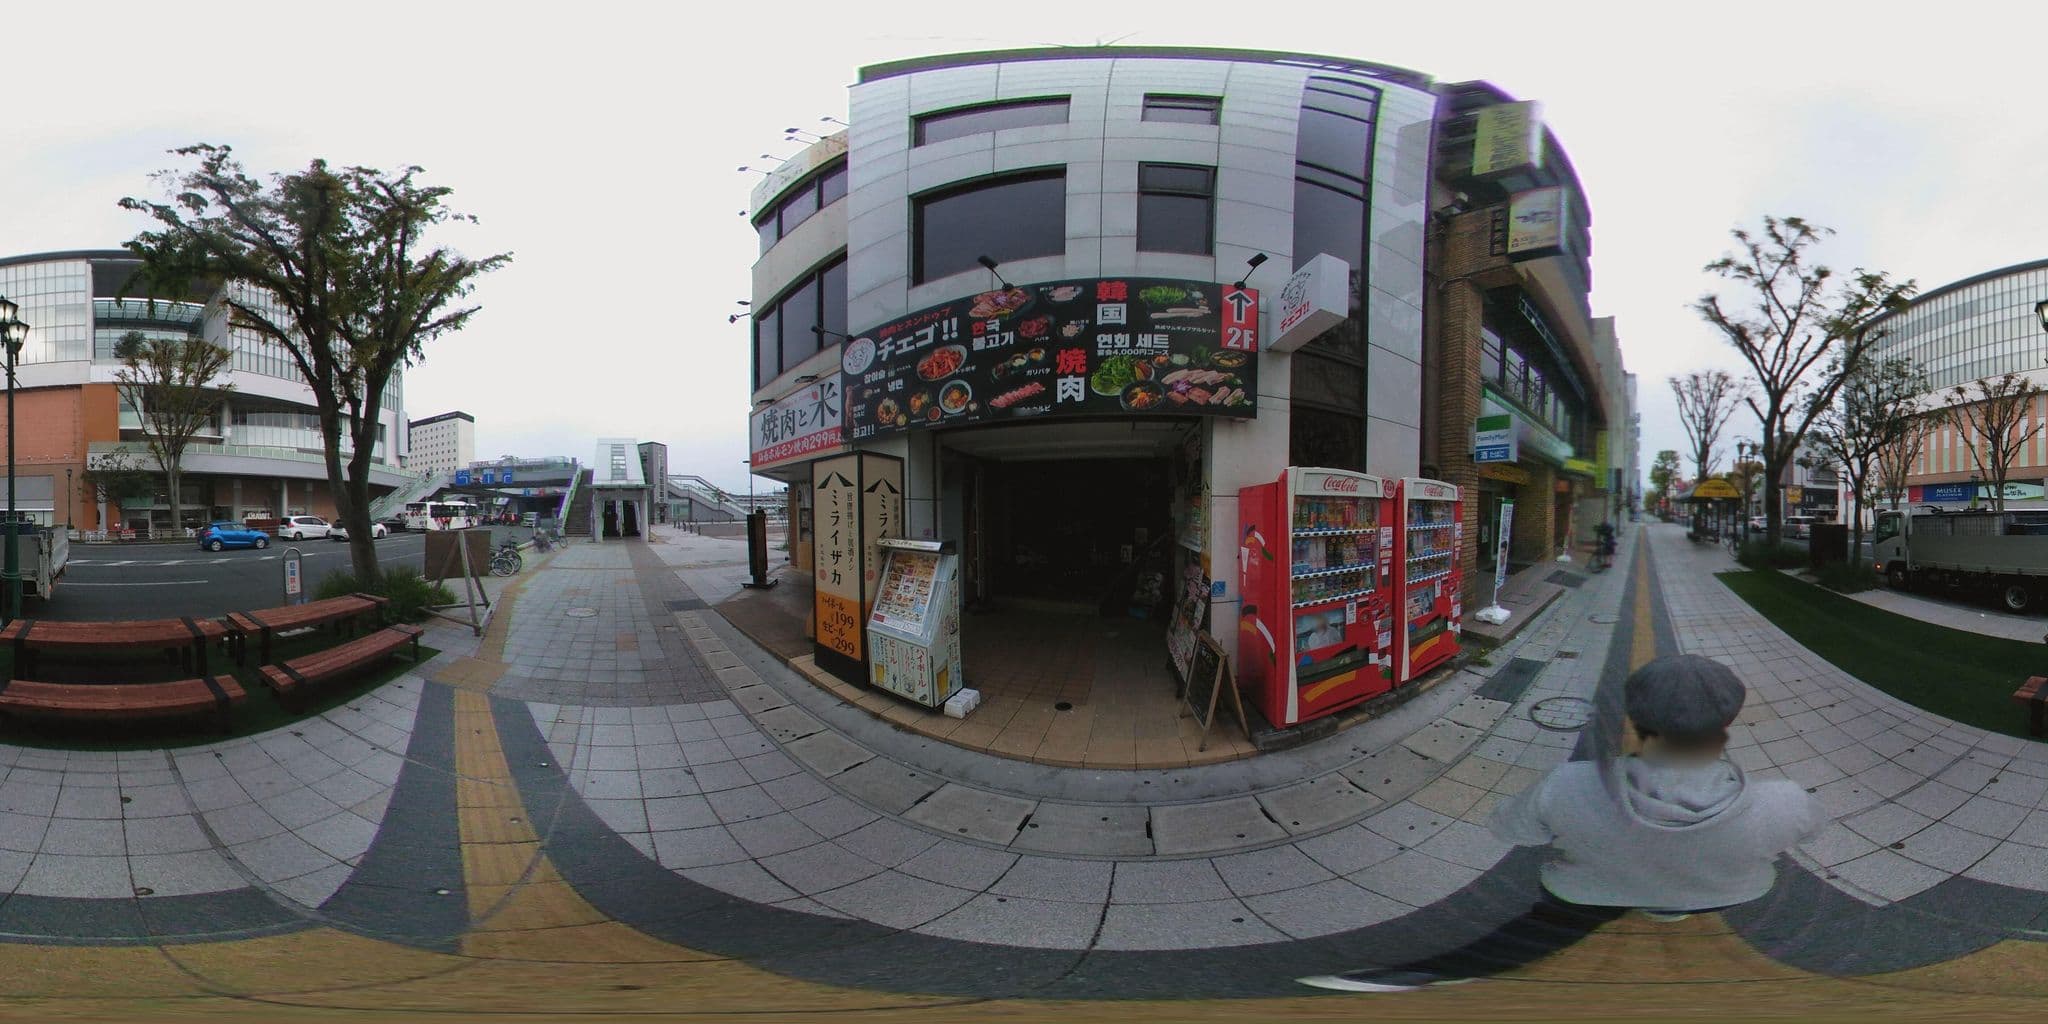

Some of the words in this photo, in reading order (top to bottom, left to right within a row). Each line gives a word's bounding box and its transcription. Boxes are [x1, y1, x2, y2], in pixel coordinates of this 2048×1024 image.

[1096, 333, 1130, 349] 연회
[1136, 333, 1170, 349] 세트
[1226, 326, 1255, 350] 2F
[1056, 346, 1088, 403] 焼肉
[1477, 433, 1510, 443] FamilyMart
[1323, 475, 1359, 492] Coca-Cola
[830, 489, 842, 586] ミライザカ
